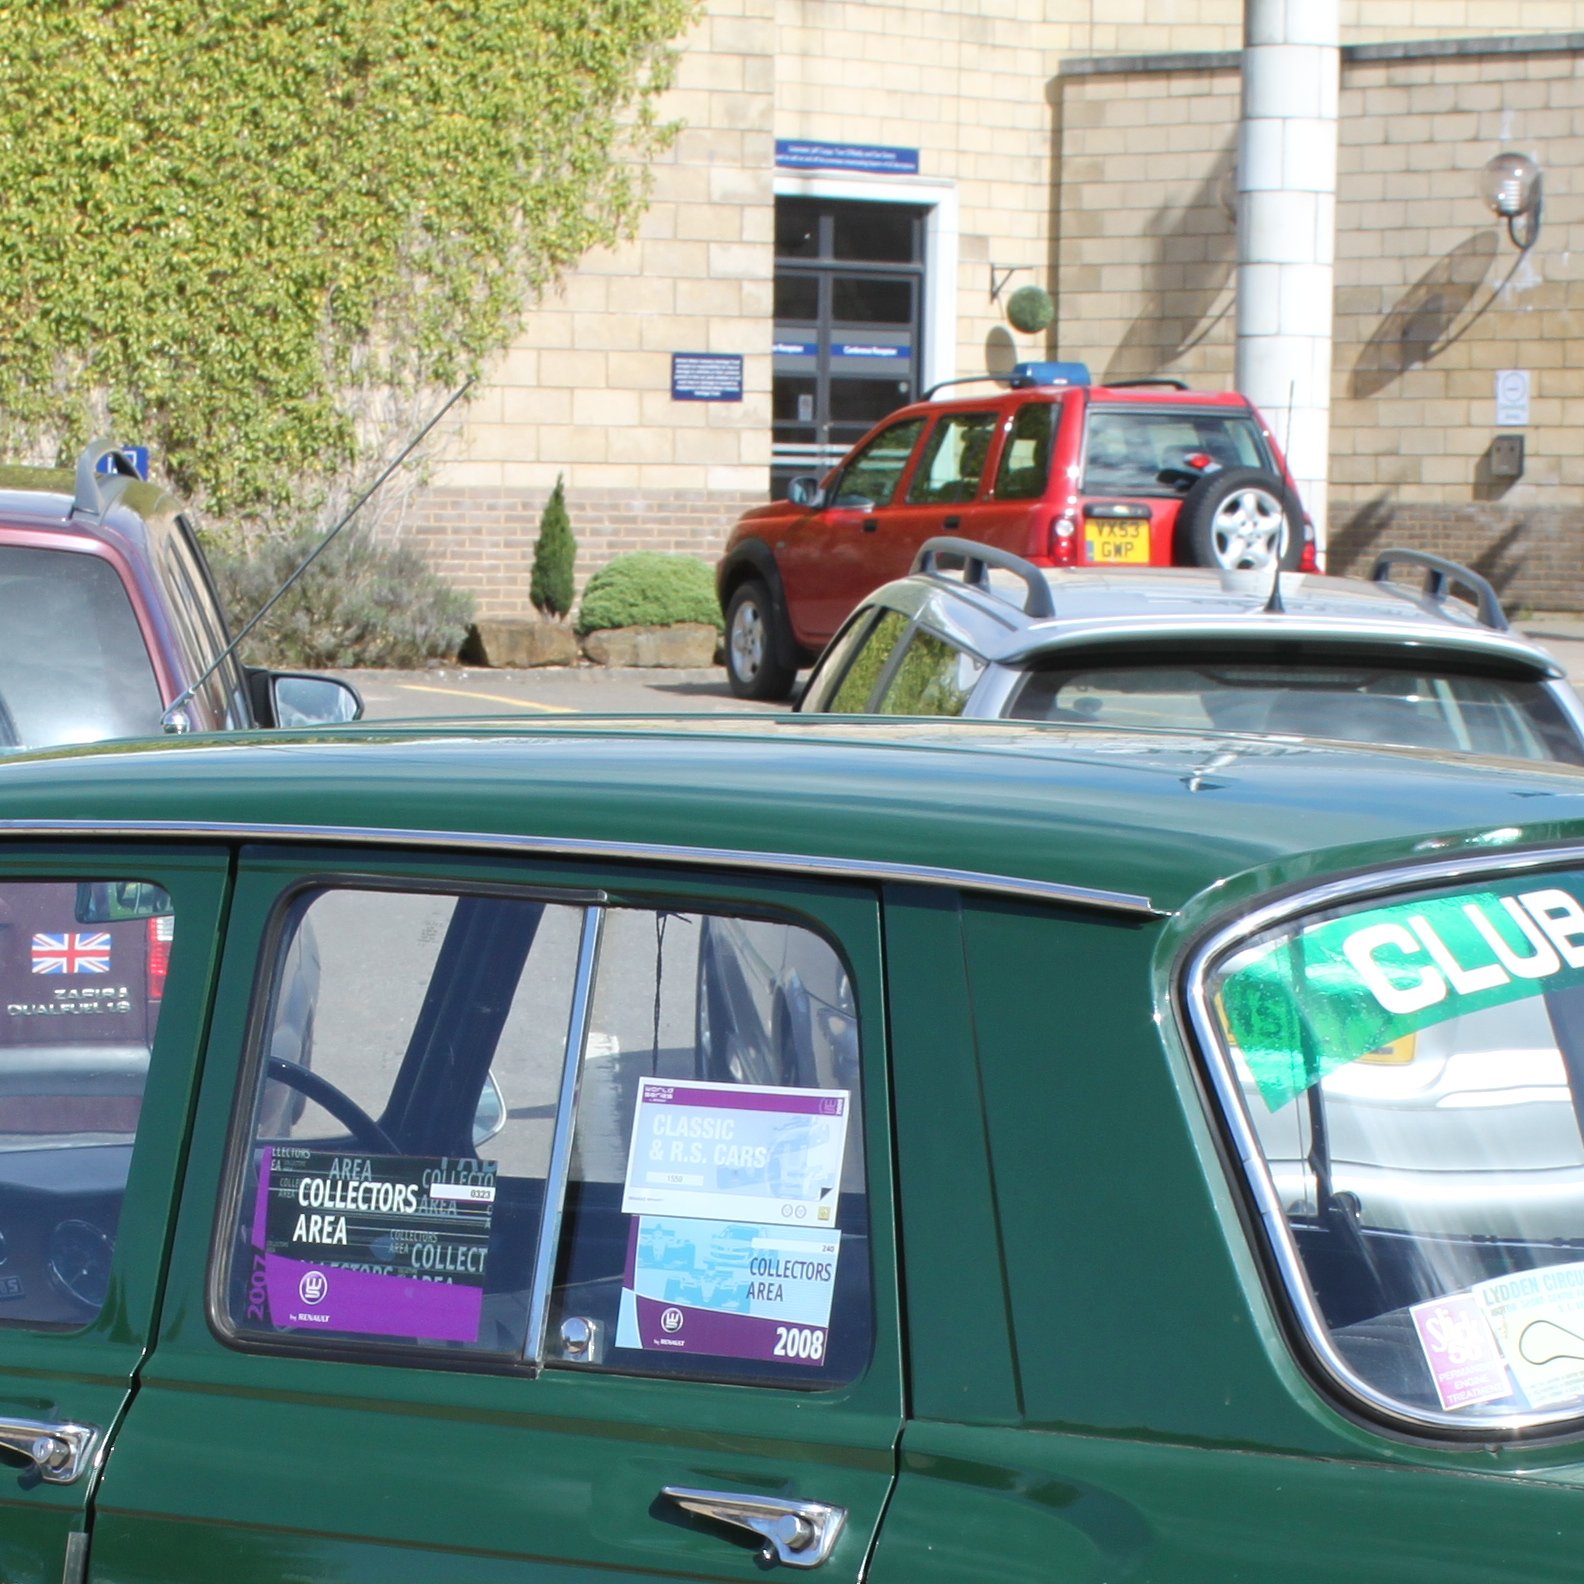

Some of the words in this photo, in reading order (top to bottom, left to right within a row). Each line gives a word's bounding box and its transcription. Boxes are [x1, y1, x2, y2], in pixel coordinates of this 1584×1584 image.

[652, 1113, 736, 1141] CLASSIC
[648, 1138, 665, 1162] &
[670, 1140, 708, 1165] R.S.
[713, 1144, 768, 1169] CARS
[328, 1157, 373, 1182] AREA
[298, 1177, 419, 1214] COLLECTORS
[292, 1213, 348, 1246] AREA
[411, 1242, 489, 1274] COLLECT
[749, 1257, 833, 1282] COLLECTORS
[746, 1281, 784, 1302] AREA
[1482, 1275, 1540, 1307] LYDDEN
[297, 1312, 331, 1323] RENAULT
[773, 1326, 825, 1360] 2008
